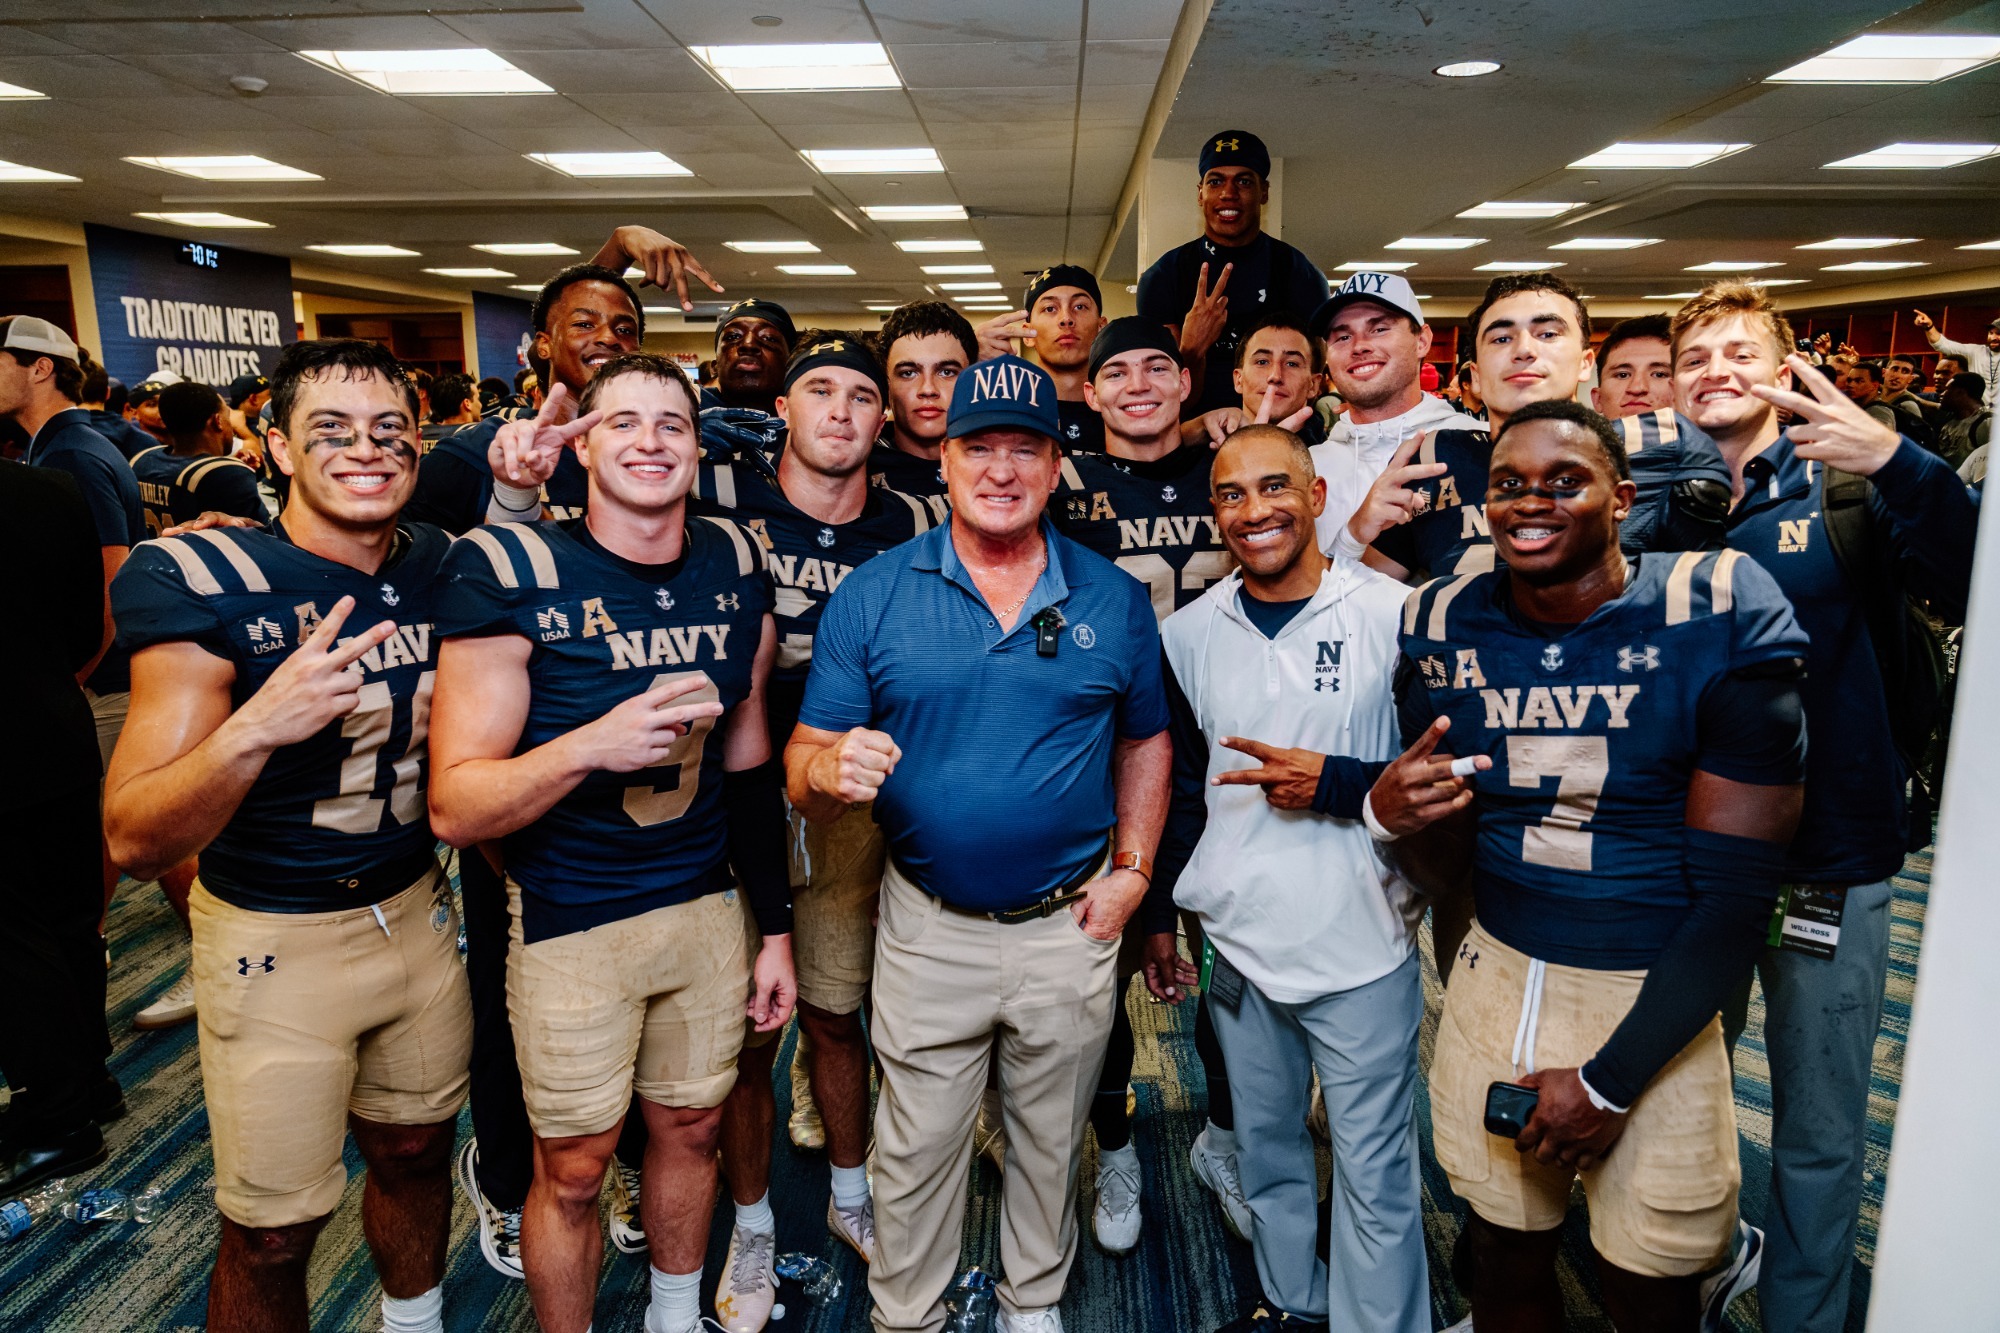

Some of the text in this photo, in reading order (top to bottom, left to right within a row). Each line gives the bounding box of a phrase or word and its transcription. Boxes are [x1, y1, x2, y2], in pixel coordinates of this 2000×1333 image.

[1335, 273, 1389, 297] NAVY
[120, 295, 282, 348] TRADITION NEVER
[156, 345, 262, 388] GRADUATES
[970, 362, 1042, 407] NAVY
[1068, 512, 1087, 520] USAA
[1412, 503, 1431, 517] USAA
[1117, 515, 1223, 550] NAVY
[1778, 519, 1811, 545] N
[1778, 544, 1808, 553] NAVY
[767, 552, 854, 594] NAV
[253, 638, 286, 655] USAA
[541, 628, 571, 642] USAA
[605, 624, 730, 671] NAVY
[337, 623, 435, 675] NAV
[1315, 640, 1344, 666] N
[1425, 677, 1448, 689] USAA
[1479, 684, 1640, 729] NAVY
[622, 670, 720, 828] 9
[1505, 735, 1610, 872] 7
[1804, 904, 1831, 914] OCTOBER
[1790, 923, 1830, 937] WILL ROSS
